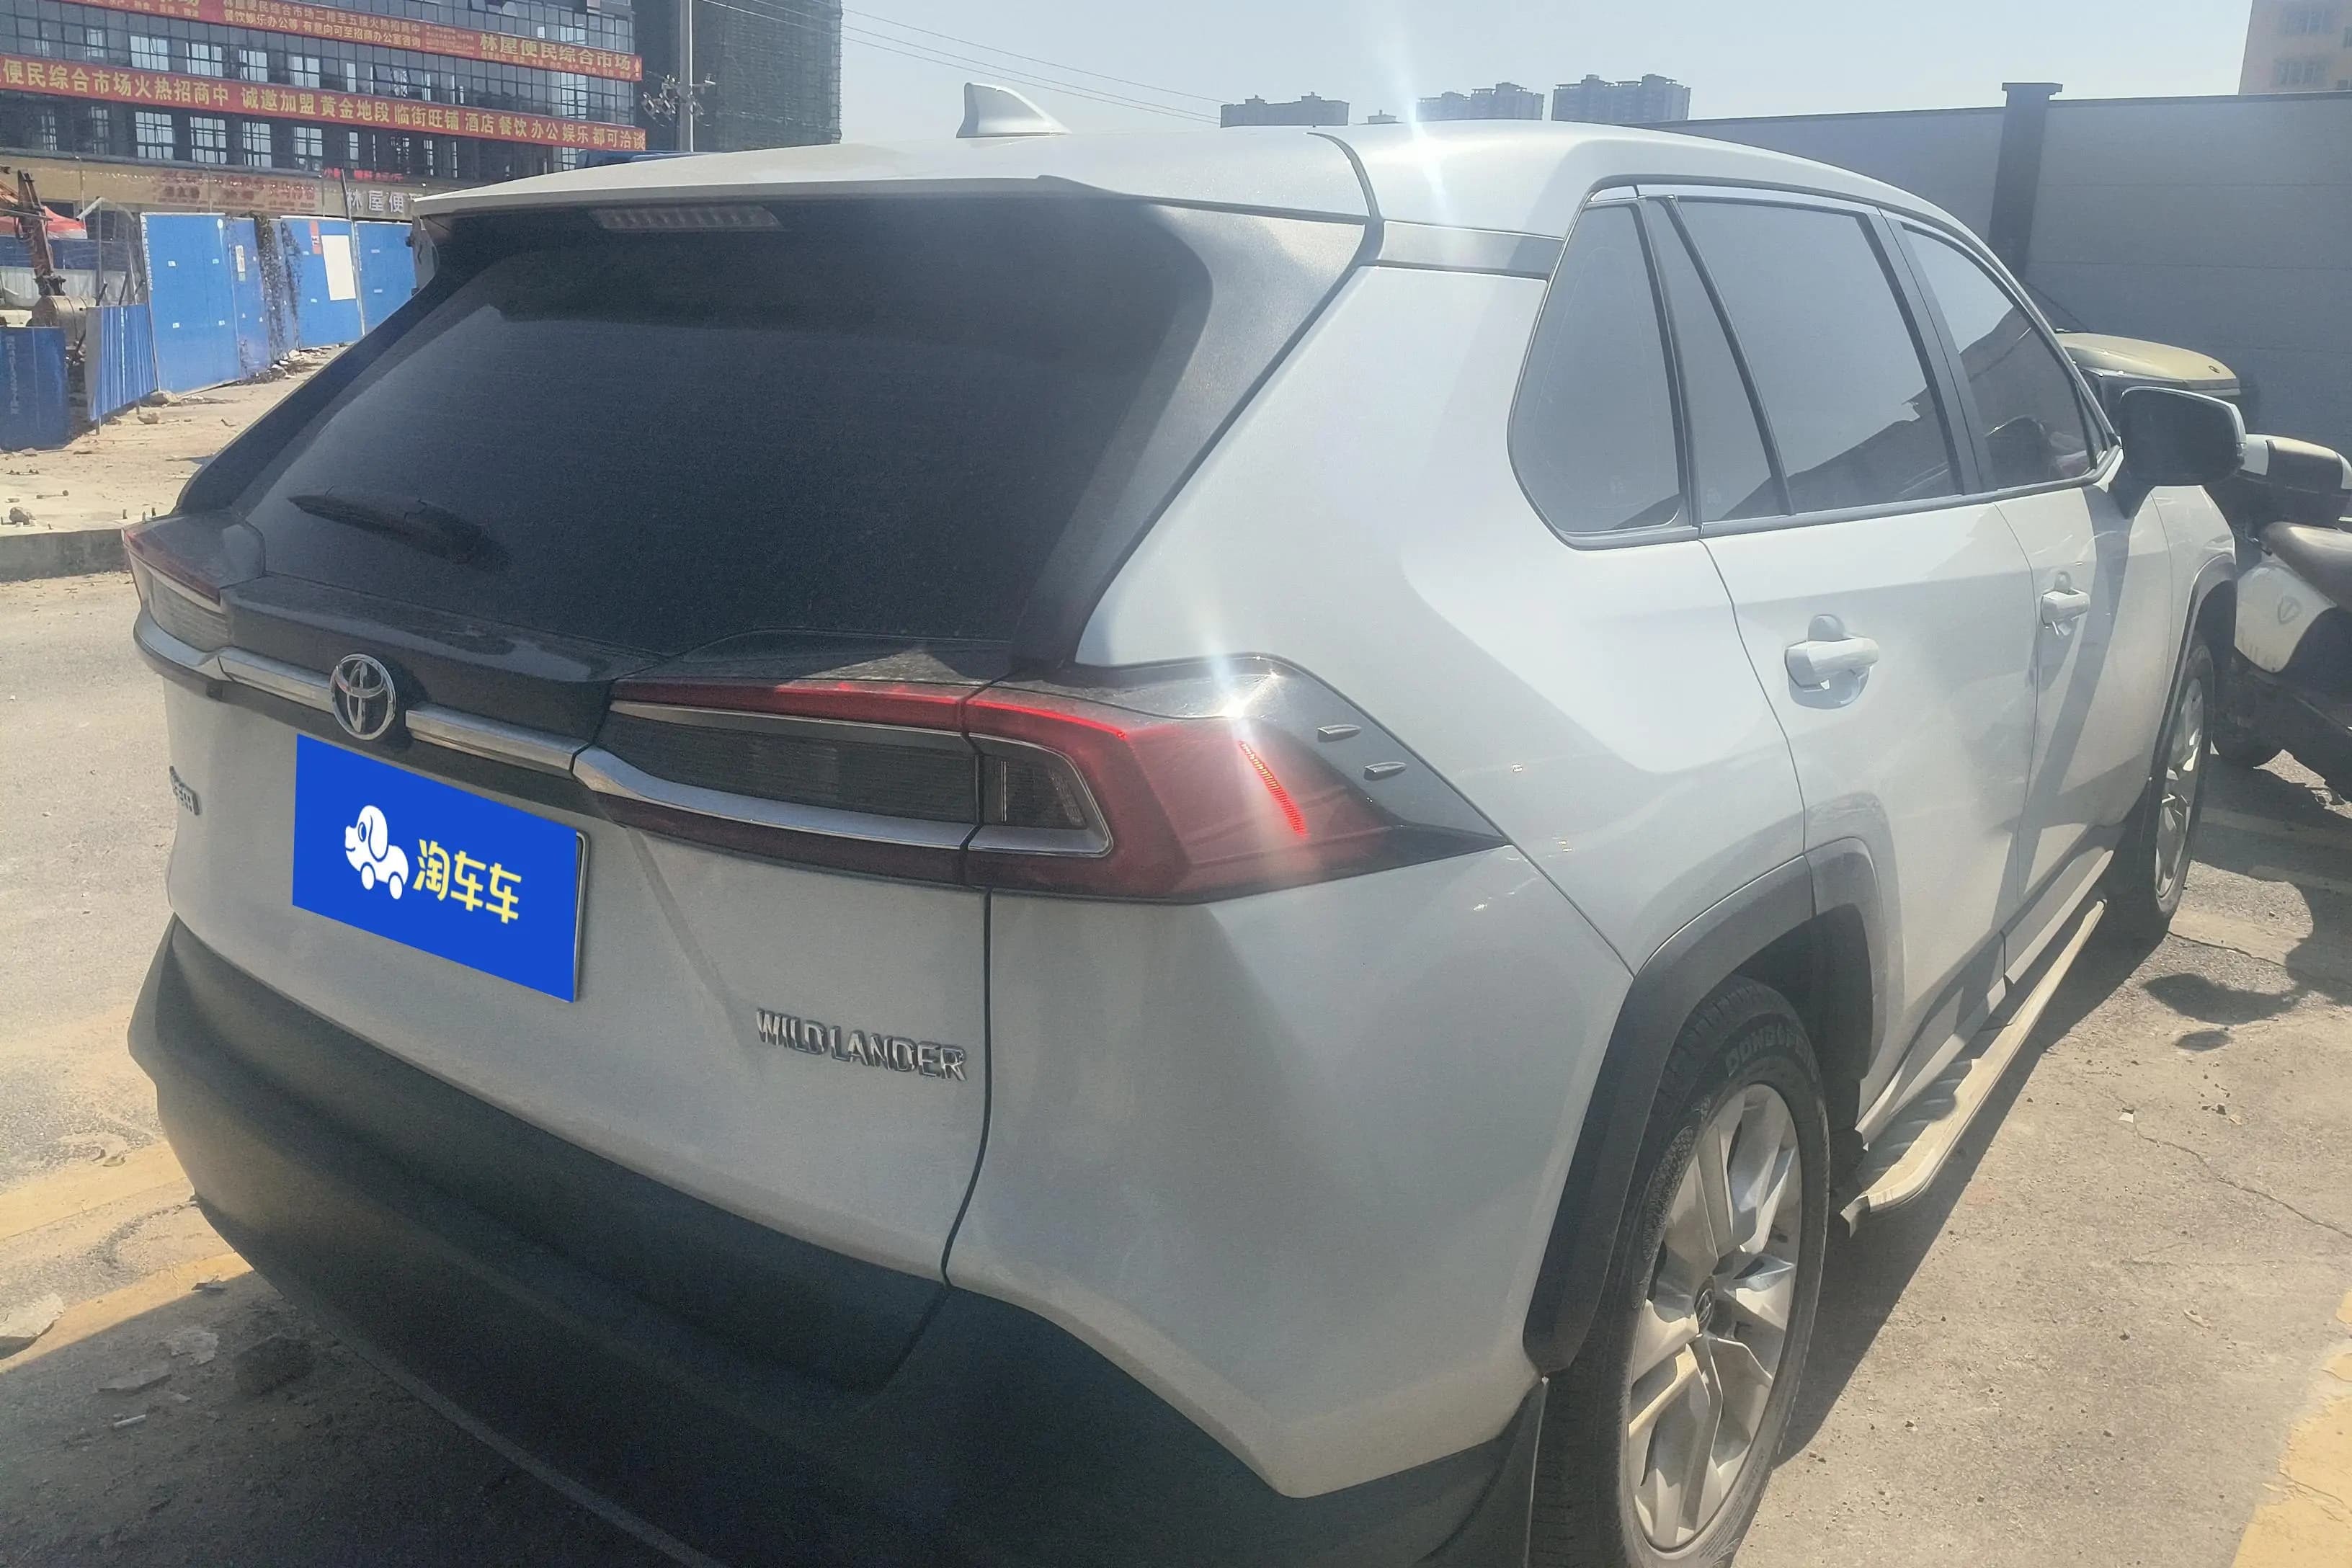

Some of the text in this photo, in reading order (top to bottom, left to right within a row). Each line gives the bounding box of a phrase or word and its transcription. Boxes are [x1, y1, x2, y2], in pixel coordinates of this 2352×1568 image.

[479, 33, 631, 71] 林屋便民综合市场
[345, 188, 424, 213] 林屋便
[756, 1008, 968, 1081] WILDLANDER
